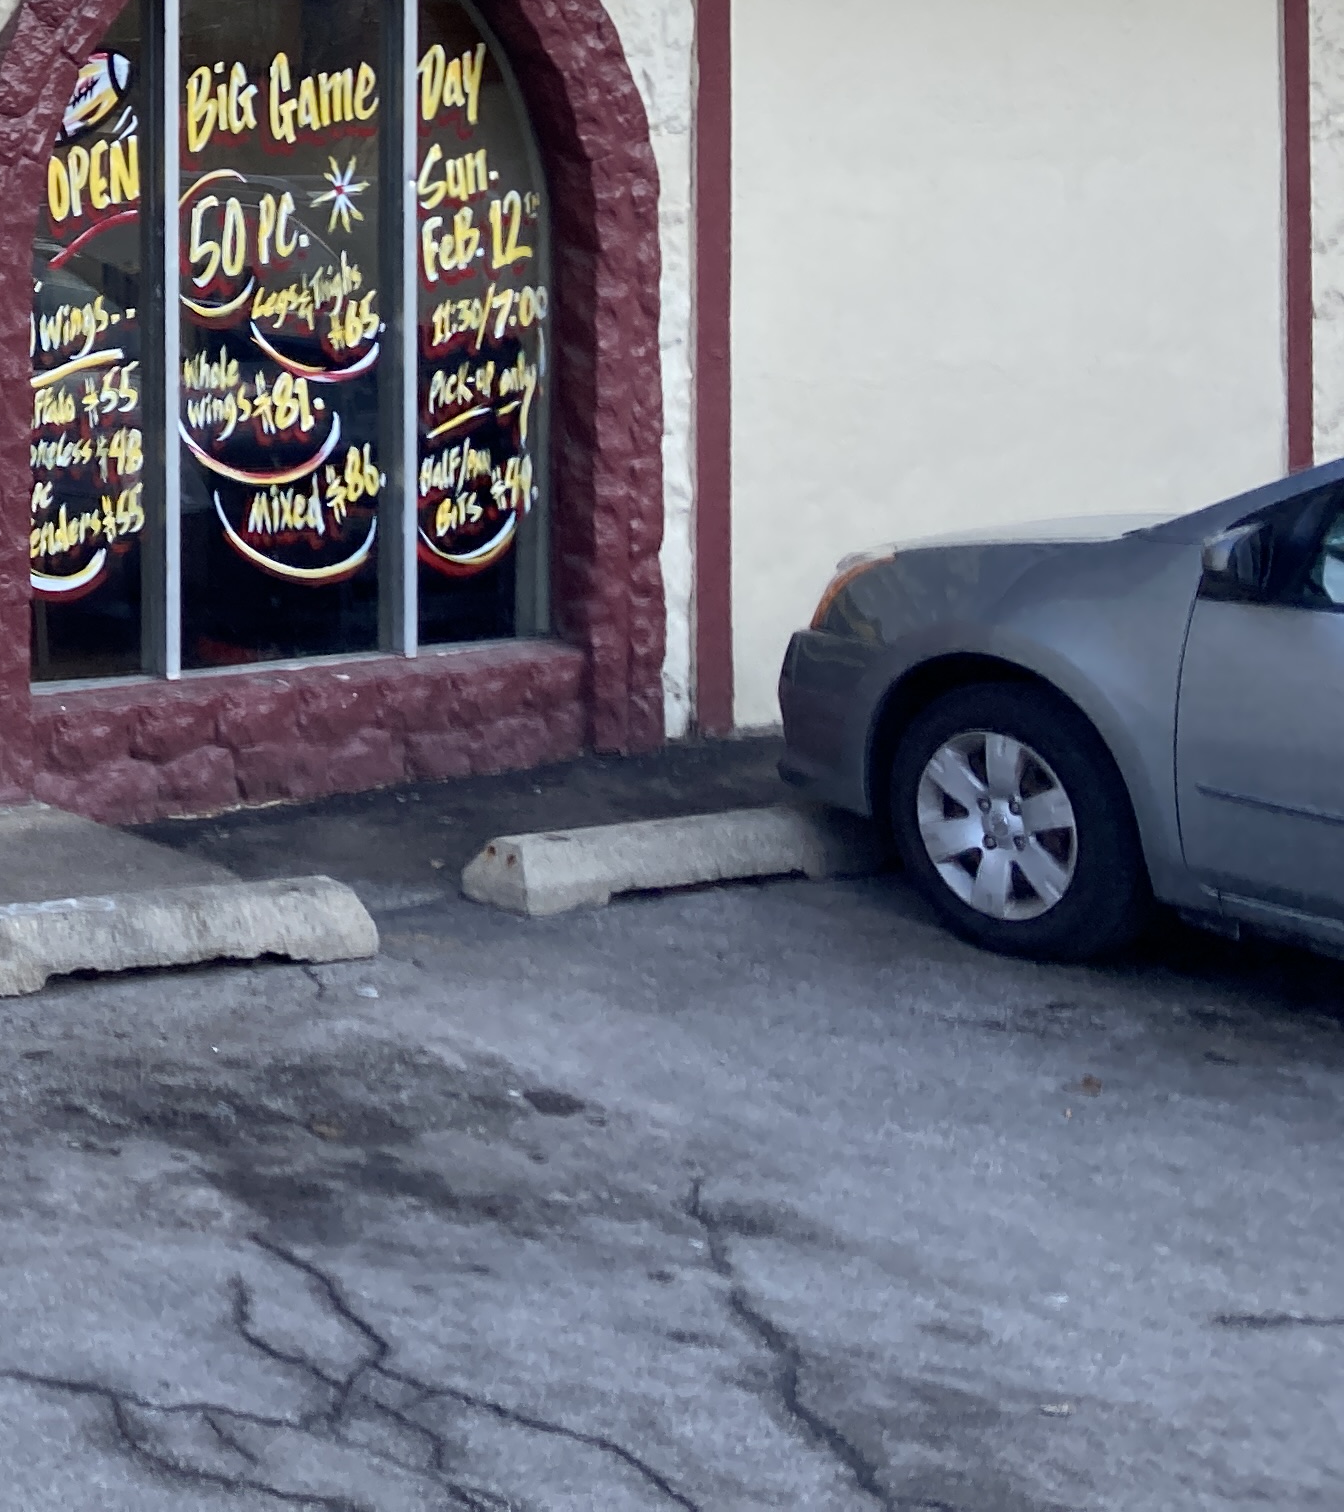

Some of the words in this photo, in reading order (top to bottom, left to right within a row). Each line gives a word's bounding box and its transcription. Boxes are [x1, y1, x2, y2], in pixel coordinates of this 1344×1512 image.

[269, 52, 380, 144] Game
[48, 134, 141, 222] OPEN
[189, 194, 247, 288] 50
